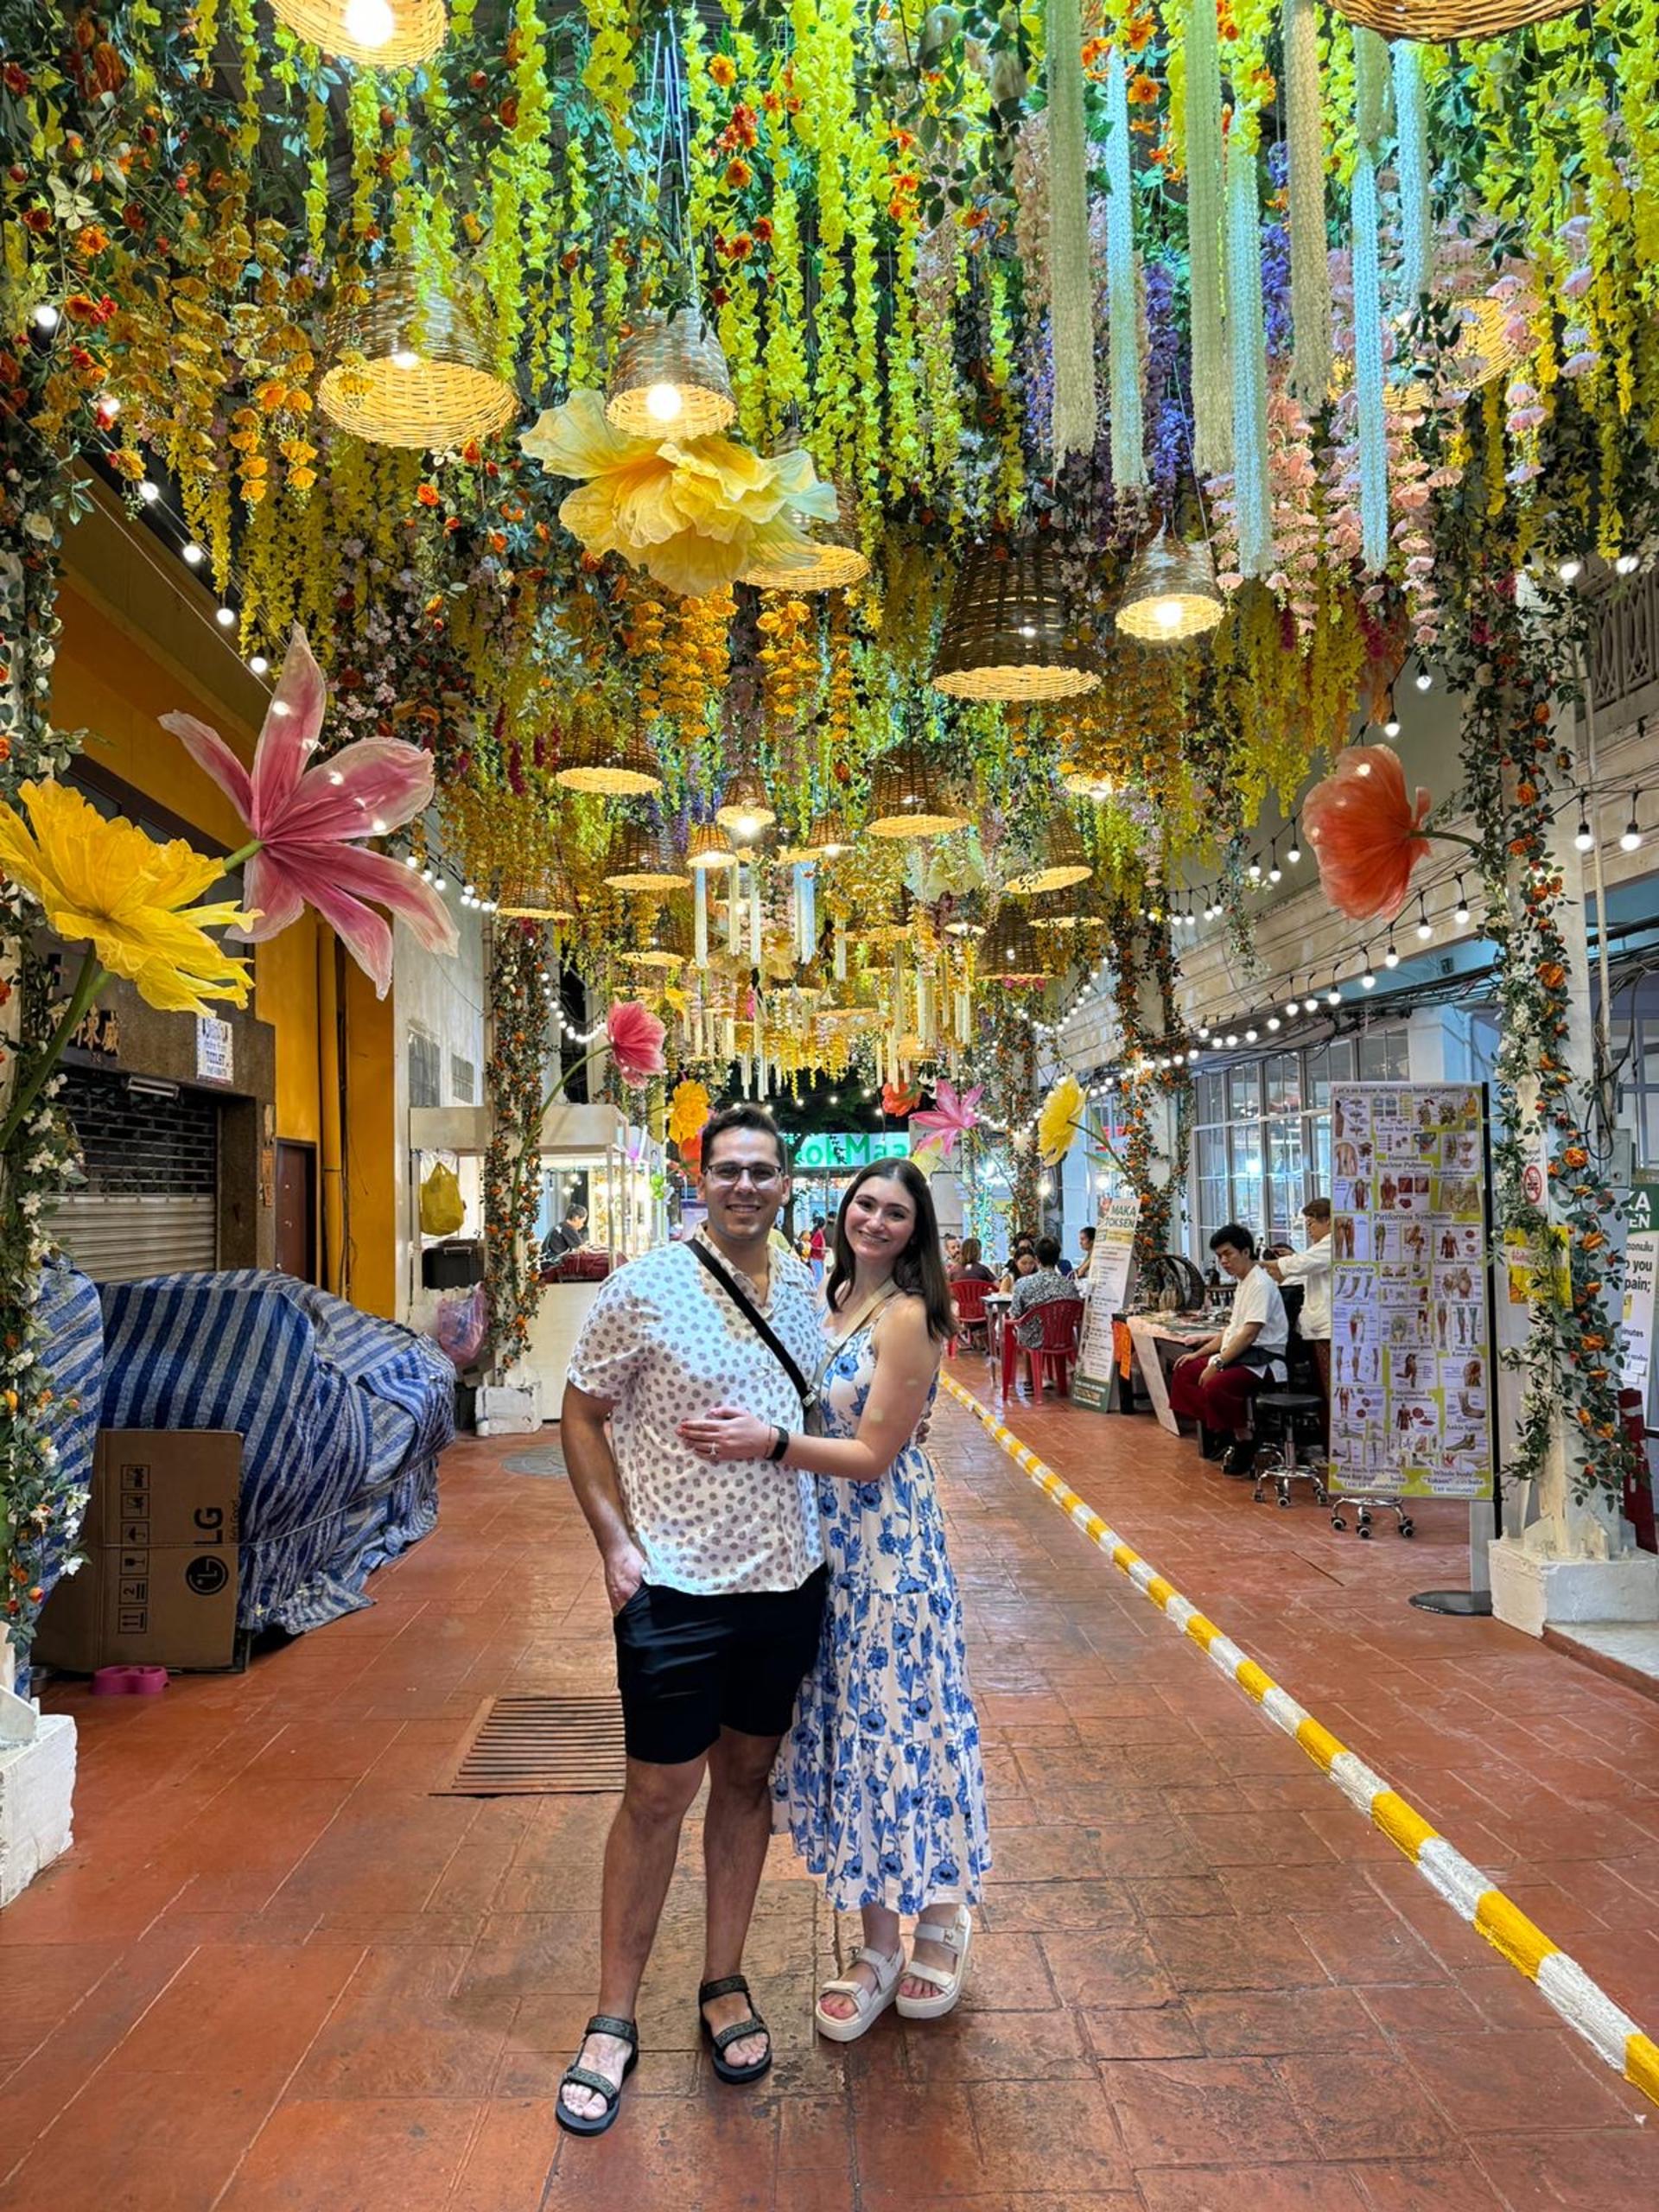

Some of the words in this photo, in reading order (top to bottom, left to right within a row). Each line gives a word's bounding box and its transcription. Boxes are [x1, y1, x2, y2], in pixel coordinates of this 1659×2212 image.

[1111, 1205, 1137, 1217] MAKA
[1632, 1261, 1652, 1274] you
[1624, 1276, 1651, 1294] pain;
[194, 1507, 224, 1548] LG
